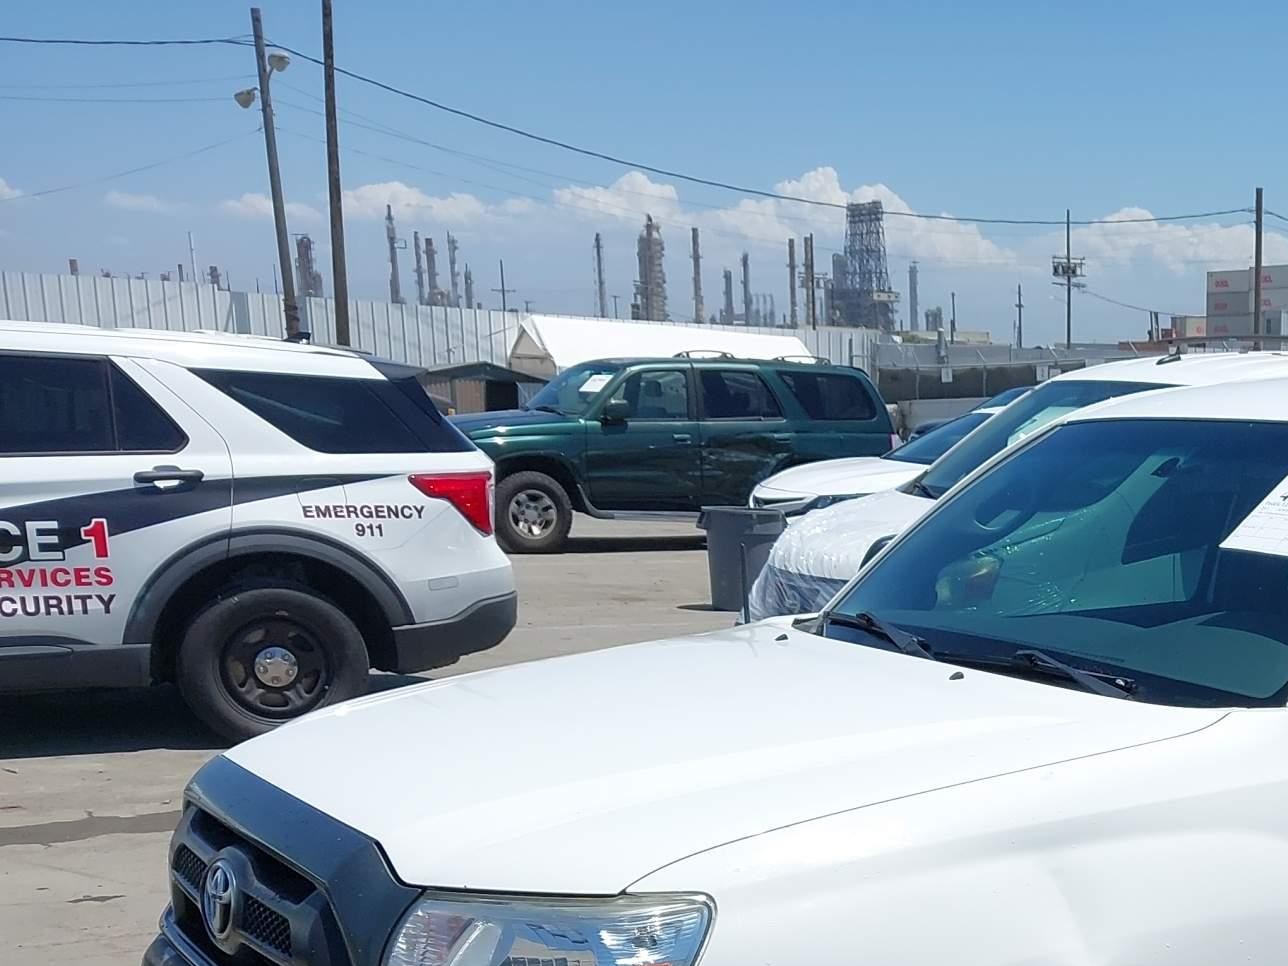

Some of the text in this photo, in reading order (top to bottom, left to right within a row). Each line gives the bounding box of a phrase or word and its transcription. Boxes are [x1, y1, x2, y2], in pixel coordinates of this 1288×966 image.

[302, 504, 424, 520] EMERGENCY
[80, 518, 109, 559] 1
[354, 522, 384, 538] 911
[0, 593, 117, 618] CURITY
